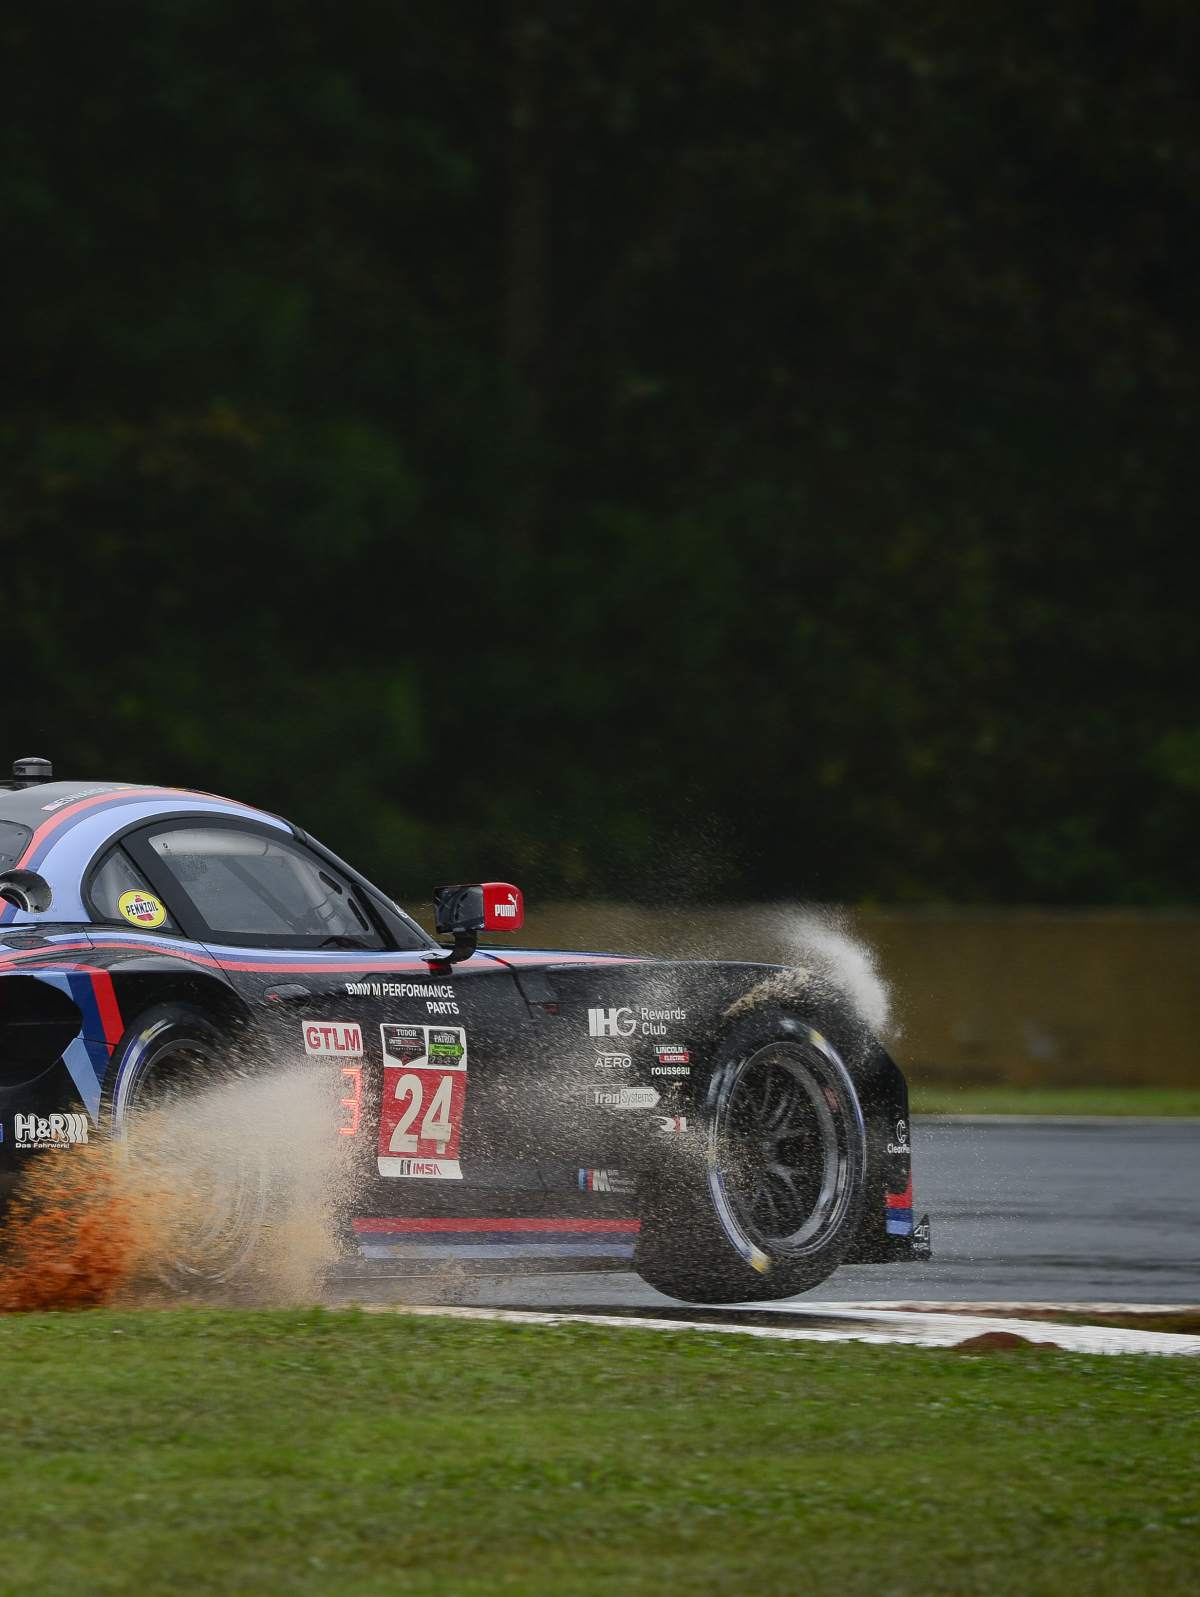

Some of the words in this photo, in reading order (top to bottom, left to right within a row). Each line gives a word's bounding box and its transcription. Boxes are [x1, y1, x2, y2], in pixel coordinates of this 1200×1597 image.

[125, 901, 159, 916] PENNZOIL
[494, 904, 516, 917] PUMA
[345, 983, 371, 996] BMW
[372, 983, 381, 996] M
[382, 983, 455, 999] PERFORMANCE
[425, 1001, 460, 1015] PARTS
[588, 1008, 637, 1037] IHG
[641, 1007, 687, 1021] Rewards
[642, 1022, 667, 1035] Club
[305, 1026, 361, 1052] GTLM
[397, 1029, 417, 1037] TUDOR
[655, 1046, 684, 1054] LINCOLN
[594, 1058, 632, 1068] AERO
[651, 1066, 690, 1075] rousseau
[388, 1073, 454, 1155] 24
[15, 1113, 69, 1142] H&R
[412, 1163, 442, 1176] IMSA
